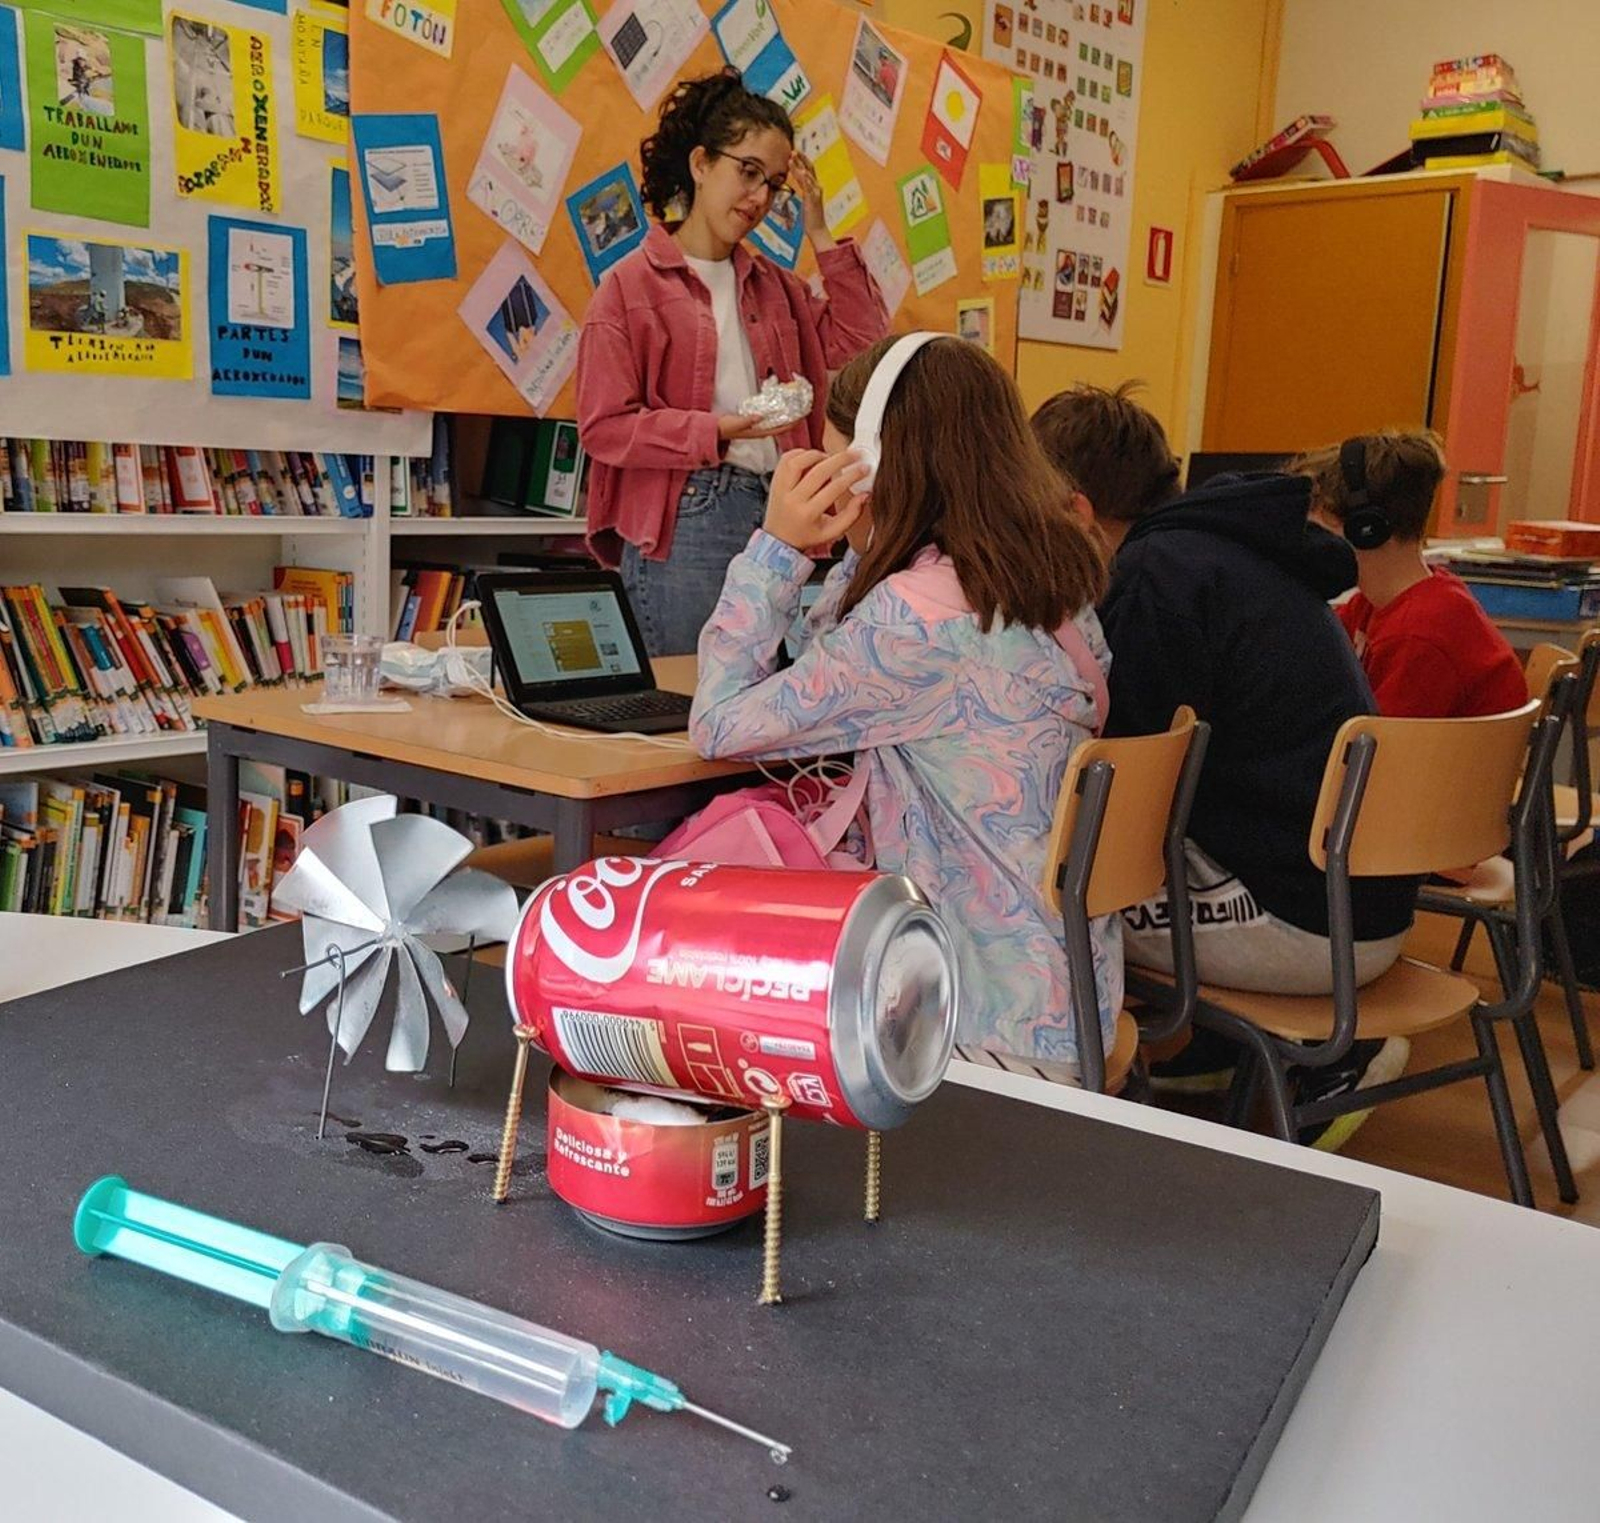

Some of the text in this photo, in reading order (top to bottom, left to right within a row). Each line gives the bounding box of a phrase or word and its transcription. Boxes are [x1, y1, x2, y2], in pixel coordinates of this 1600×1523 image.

[71, 131, 103, 150] DUN
[217, 326, 290, 343] PARTES
[242, 347, 273, 362] DUN
[556, 1126, 628, 1164] Deliciosa y
[554, 1138, 631, 1177] Refrescante
